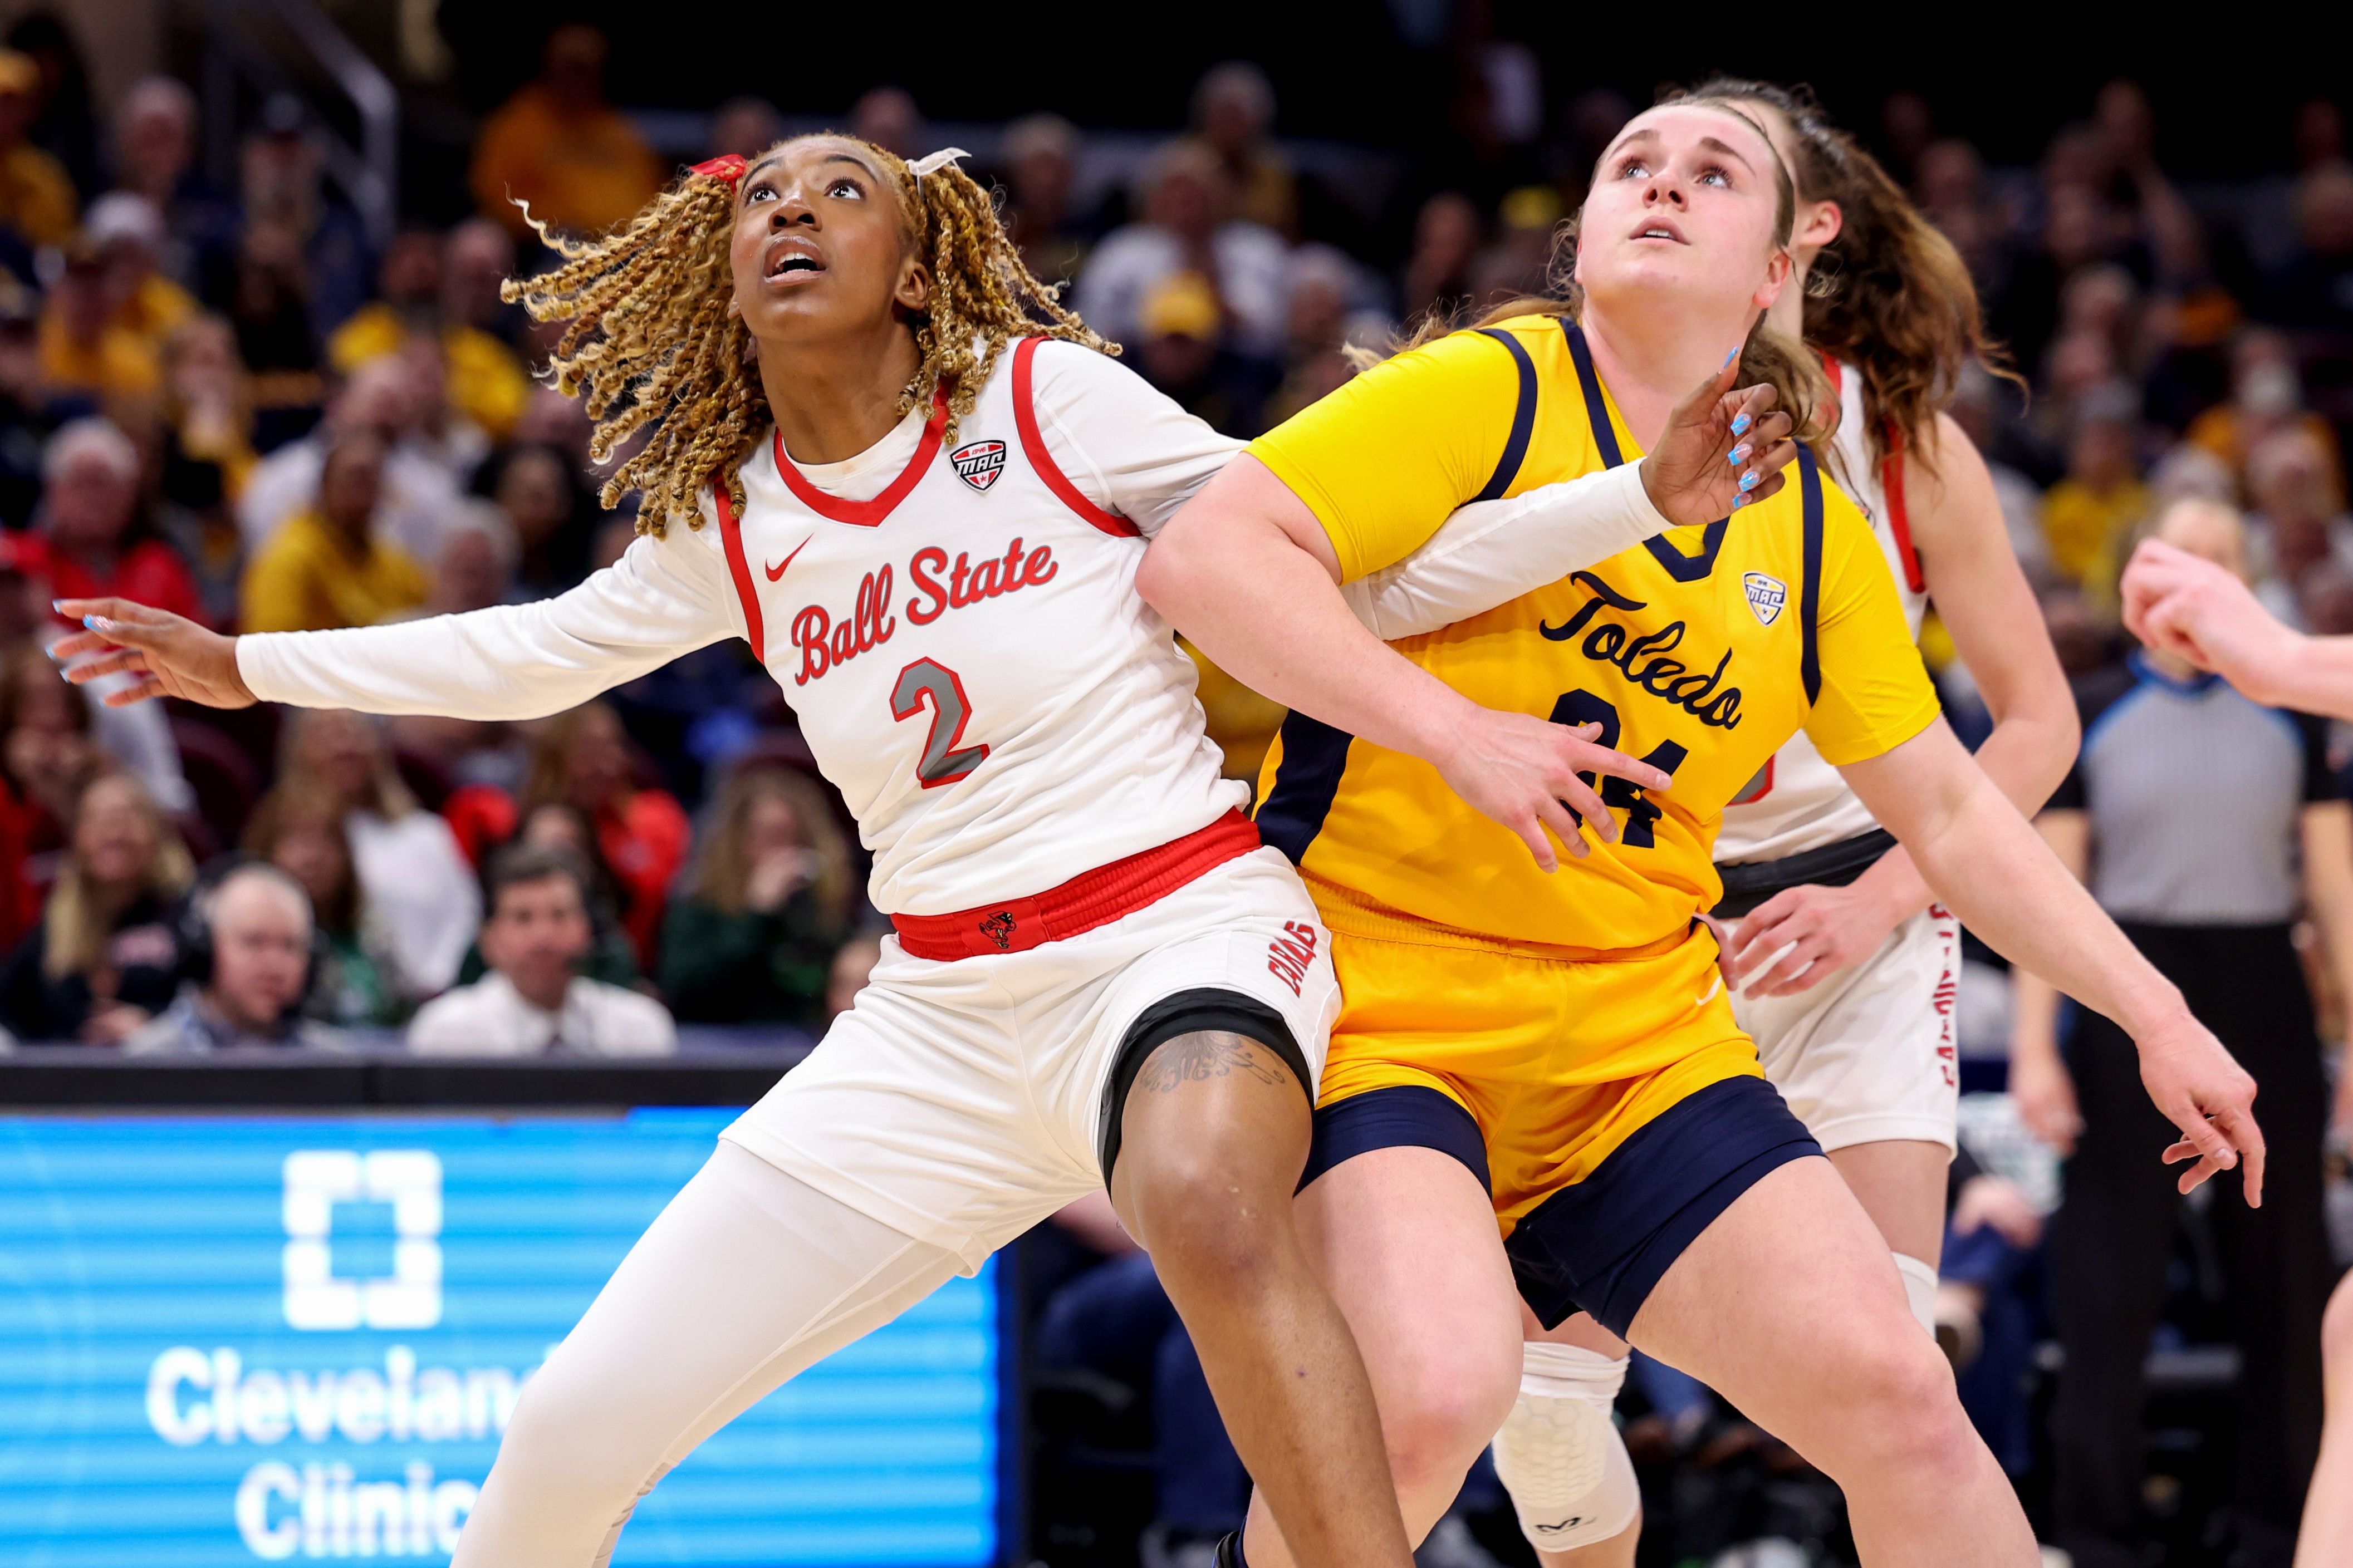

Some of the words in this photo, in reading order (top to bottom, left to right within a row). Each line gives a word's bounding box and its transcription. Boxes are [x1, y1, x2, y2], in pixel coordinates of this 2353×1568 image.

[957, 452, 1005, 475] MAC
[791, 563, 895, 686] Ball
[906, 537, 1058, 626] State
[1539, 571, 1742, 730] Toledo
[1746, 586, 1783, 608] MAC
[889, 656, 990, 789] 2
[145, 1345, 561, 1446] Clevelan
